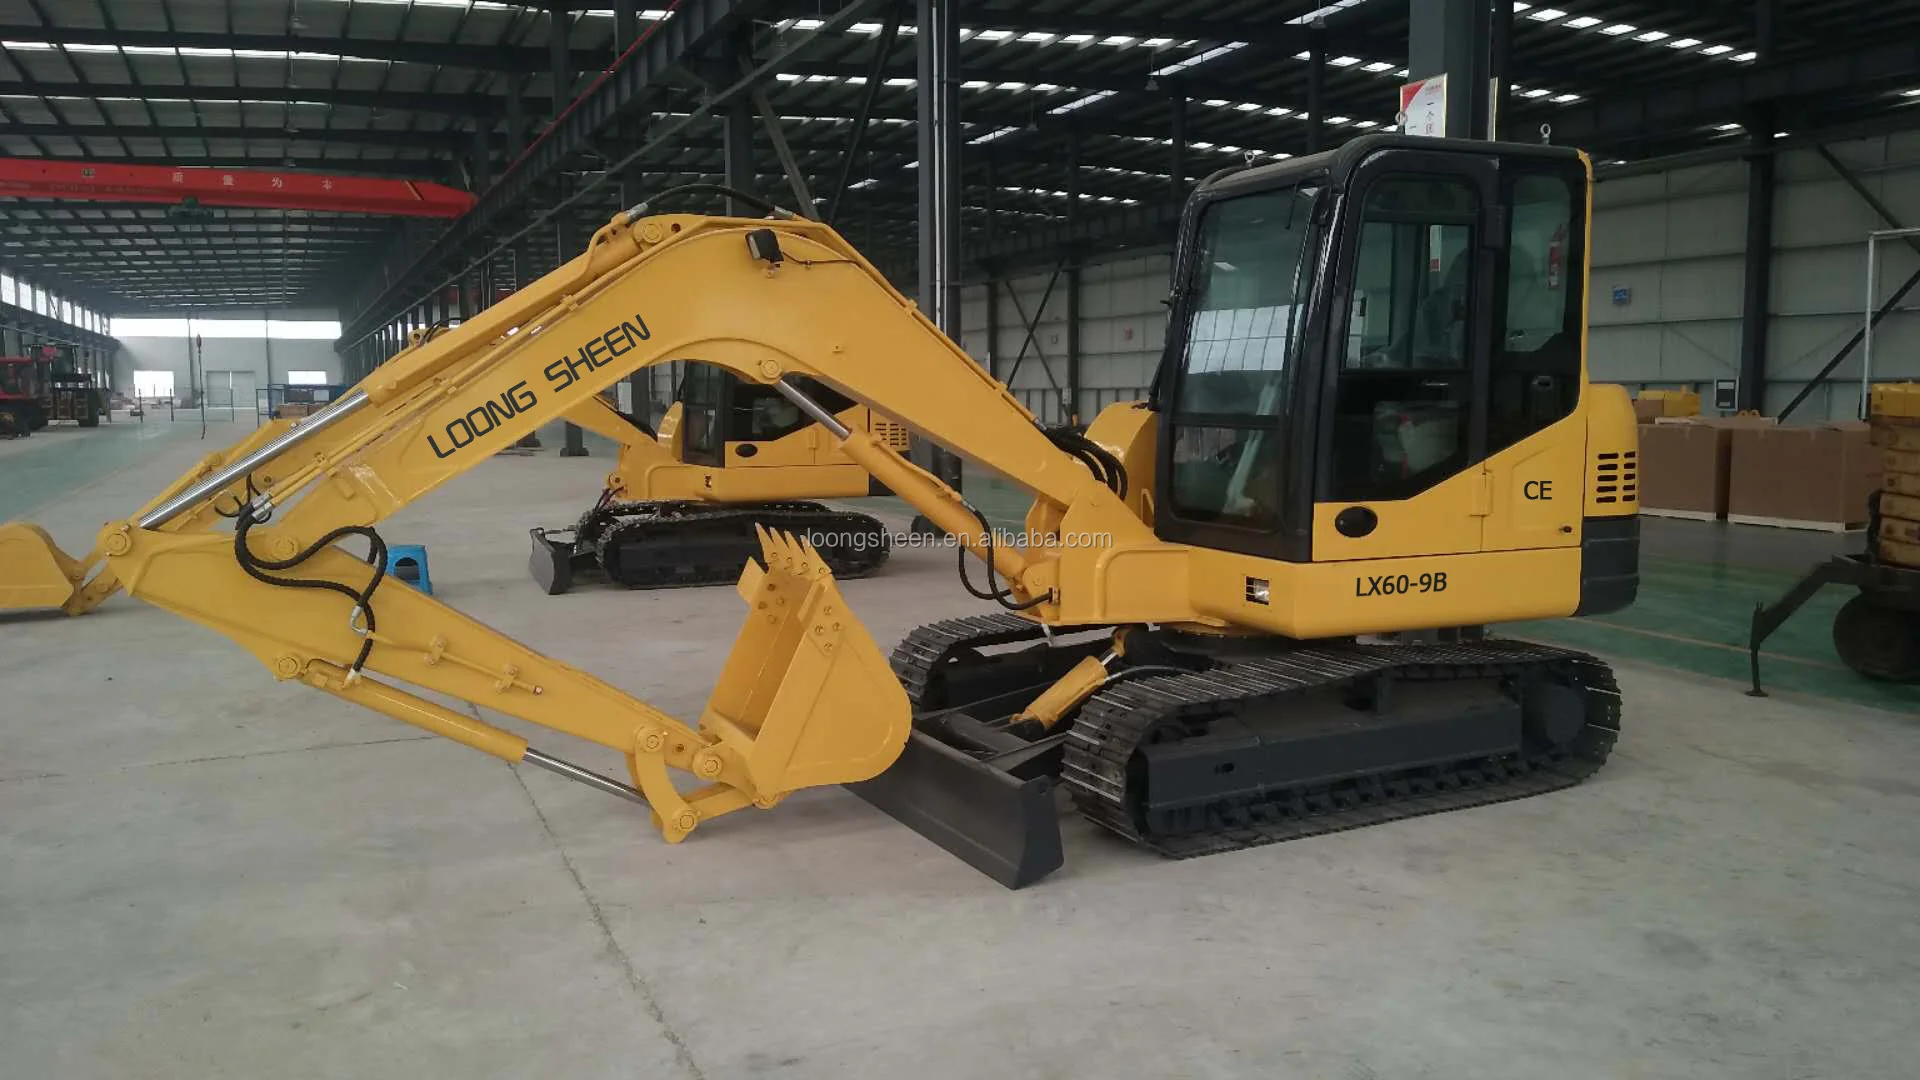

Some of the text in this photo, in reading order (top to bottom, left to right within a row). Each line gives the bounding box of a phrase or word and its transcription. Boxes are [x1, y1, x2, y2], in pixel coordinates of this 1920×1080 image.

[426, 314, 651, 459] LOONG SHEEN
[1523, 480, 1553, 500] CE
[1356, 572, 1447, 597] LX60-9B
